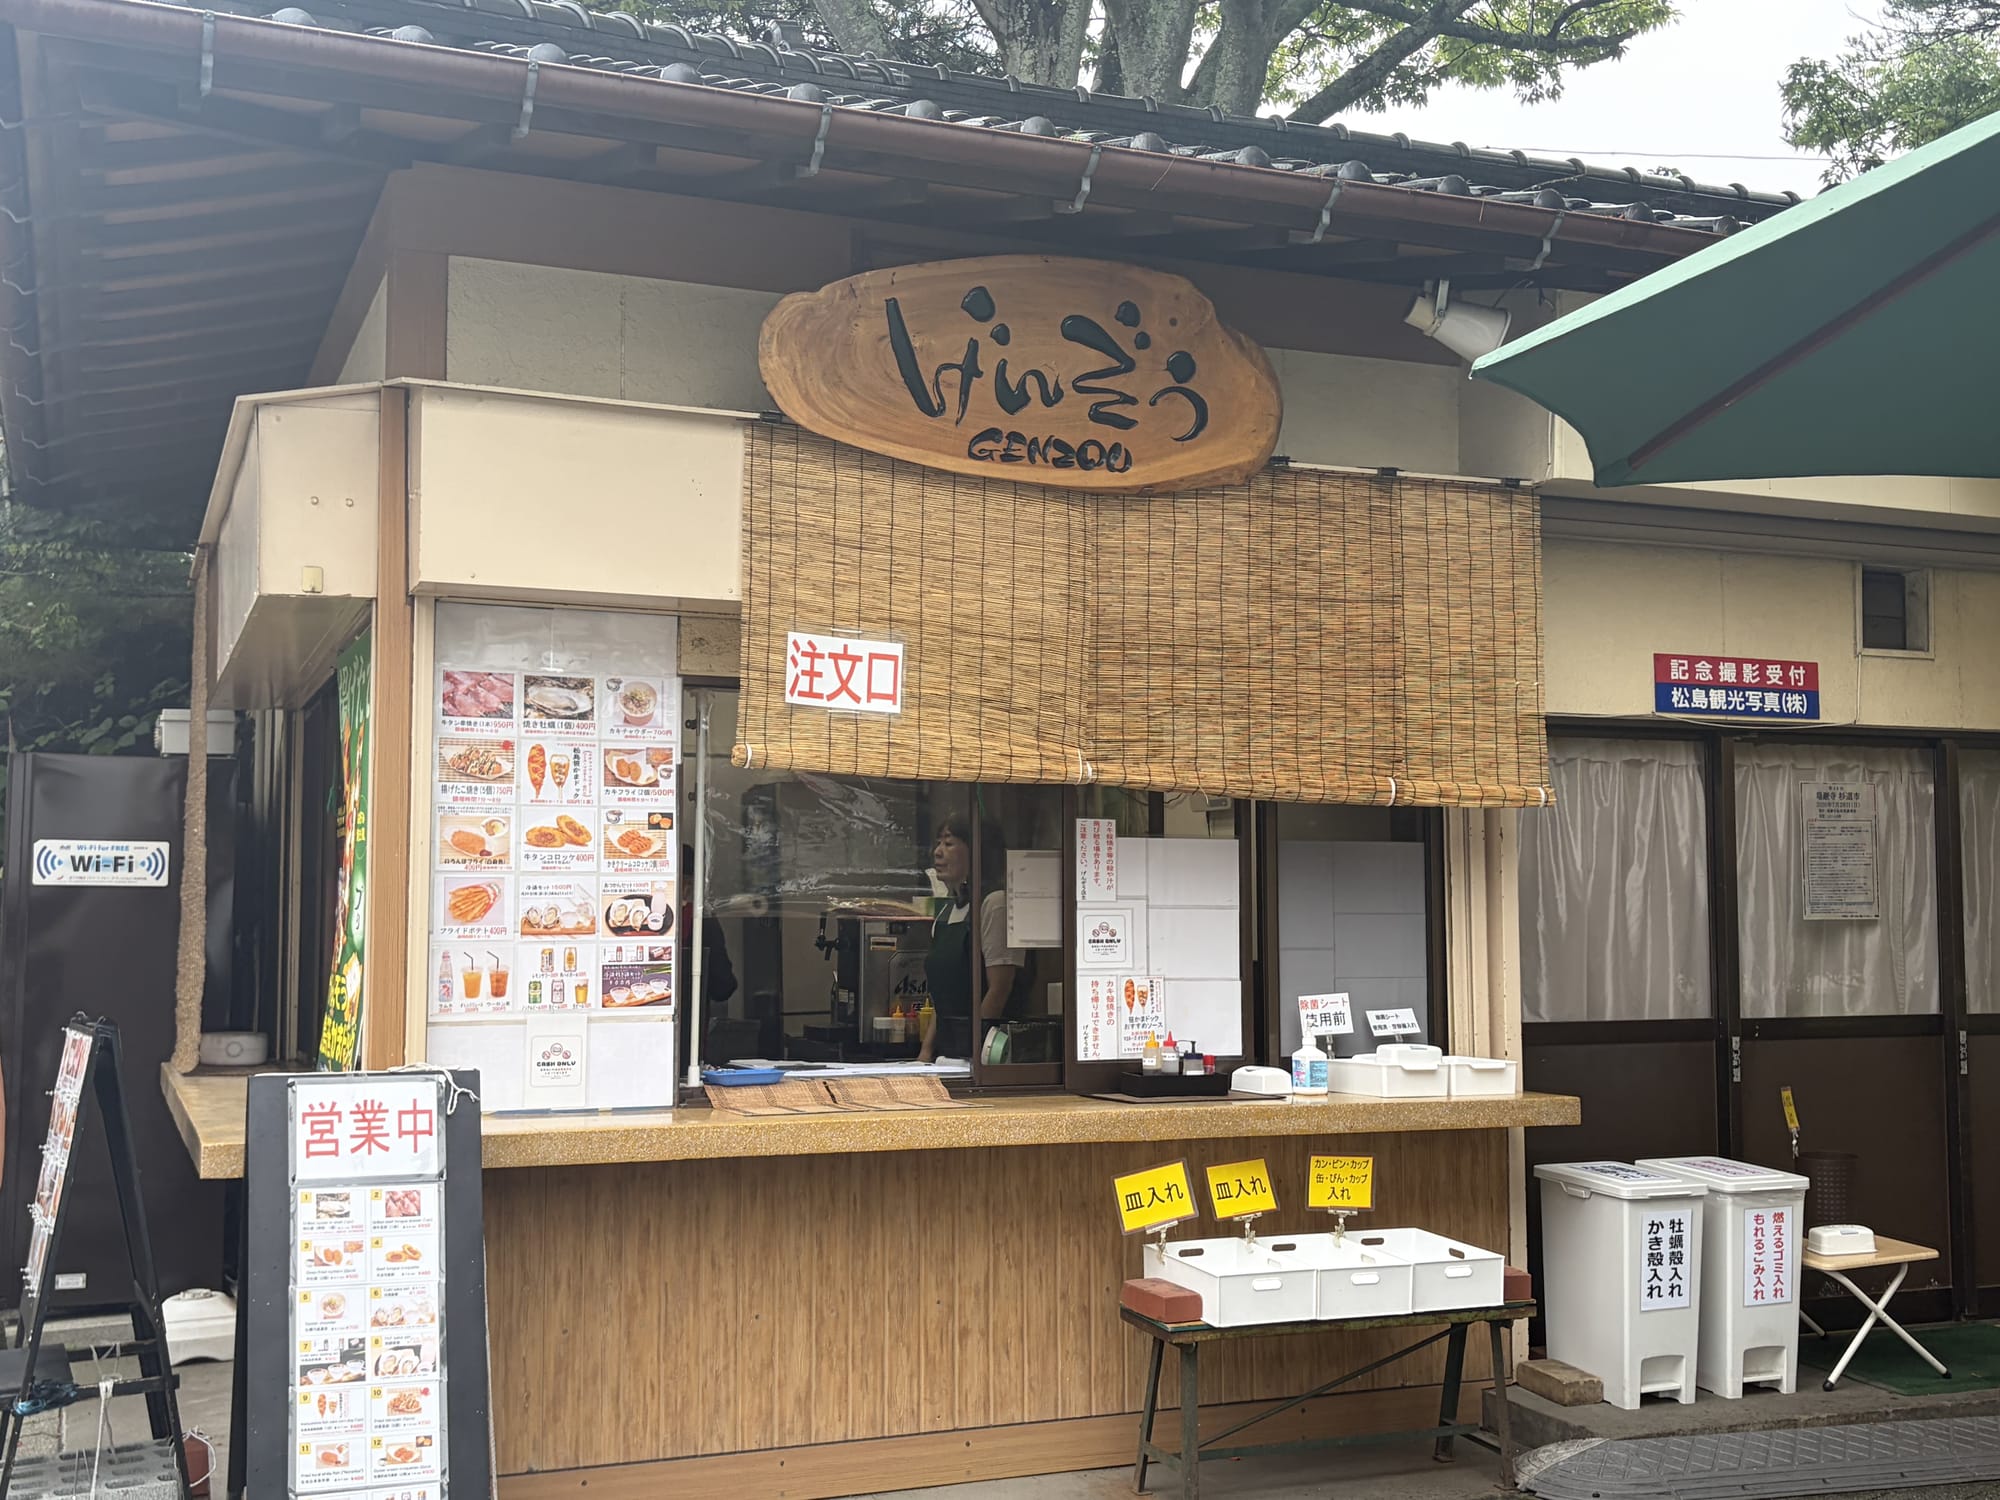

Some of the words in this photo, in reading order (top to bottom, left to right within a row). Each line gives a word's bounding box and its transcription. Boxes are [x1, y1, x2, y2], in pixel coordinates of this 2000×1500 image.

[885, 286, 1208, 441] げんぞう
[789, 639, 900, 706] 注文口
[1670, 659, 1806, 686] 記念撮影受付
[1671, 687, 1808, 714] 松島観光写真(株)
[70, 855, 134, 873] Wi-Fi
[301, 1098, 433, 1159] 営業中
[1125, 1182, 1184, 1212] 皿入れ
[1215, 1176, 1267, 1200] 皿入れ
[1327, 1186, 1351, 1201] 入れ
[1647, 1220, 1665, 1299] かき殻入れ
[1667, 1218, 1684, 1298] 牡蠣殻入れ
[1772, 1211, 1785, 1299] 燃えるゴミ入れ
